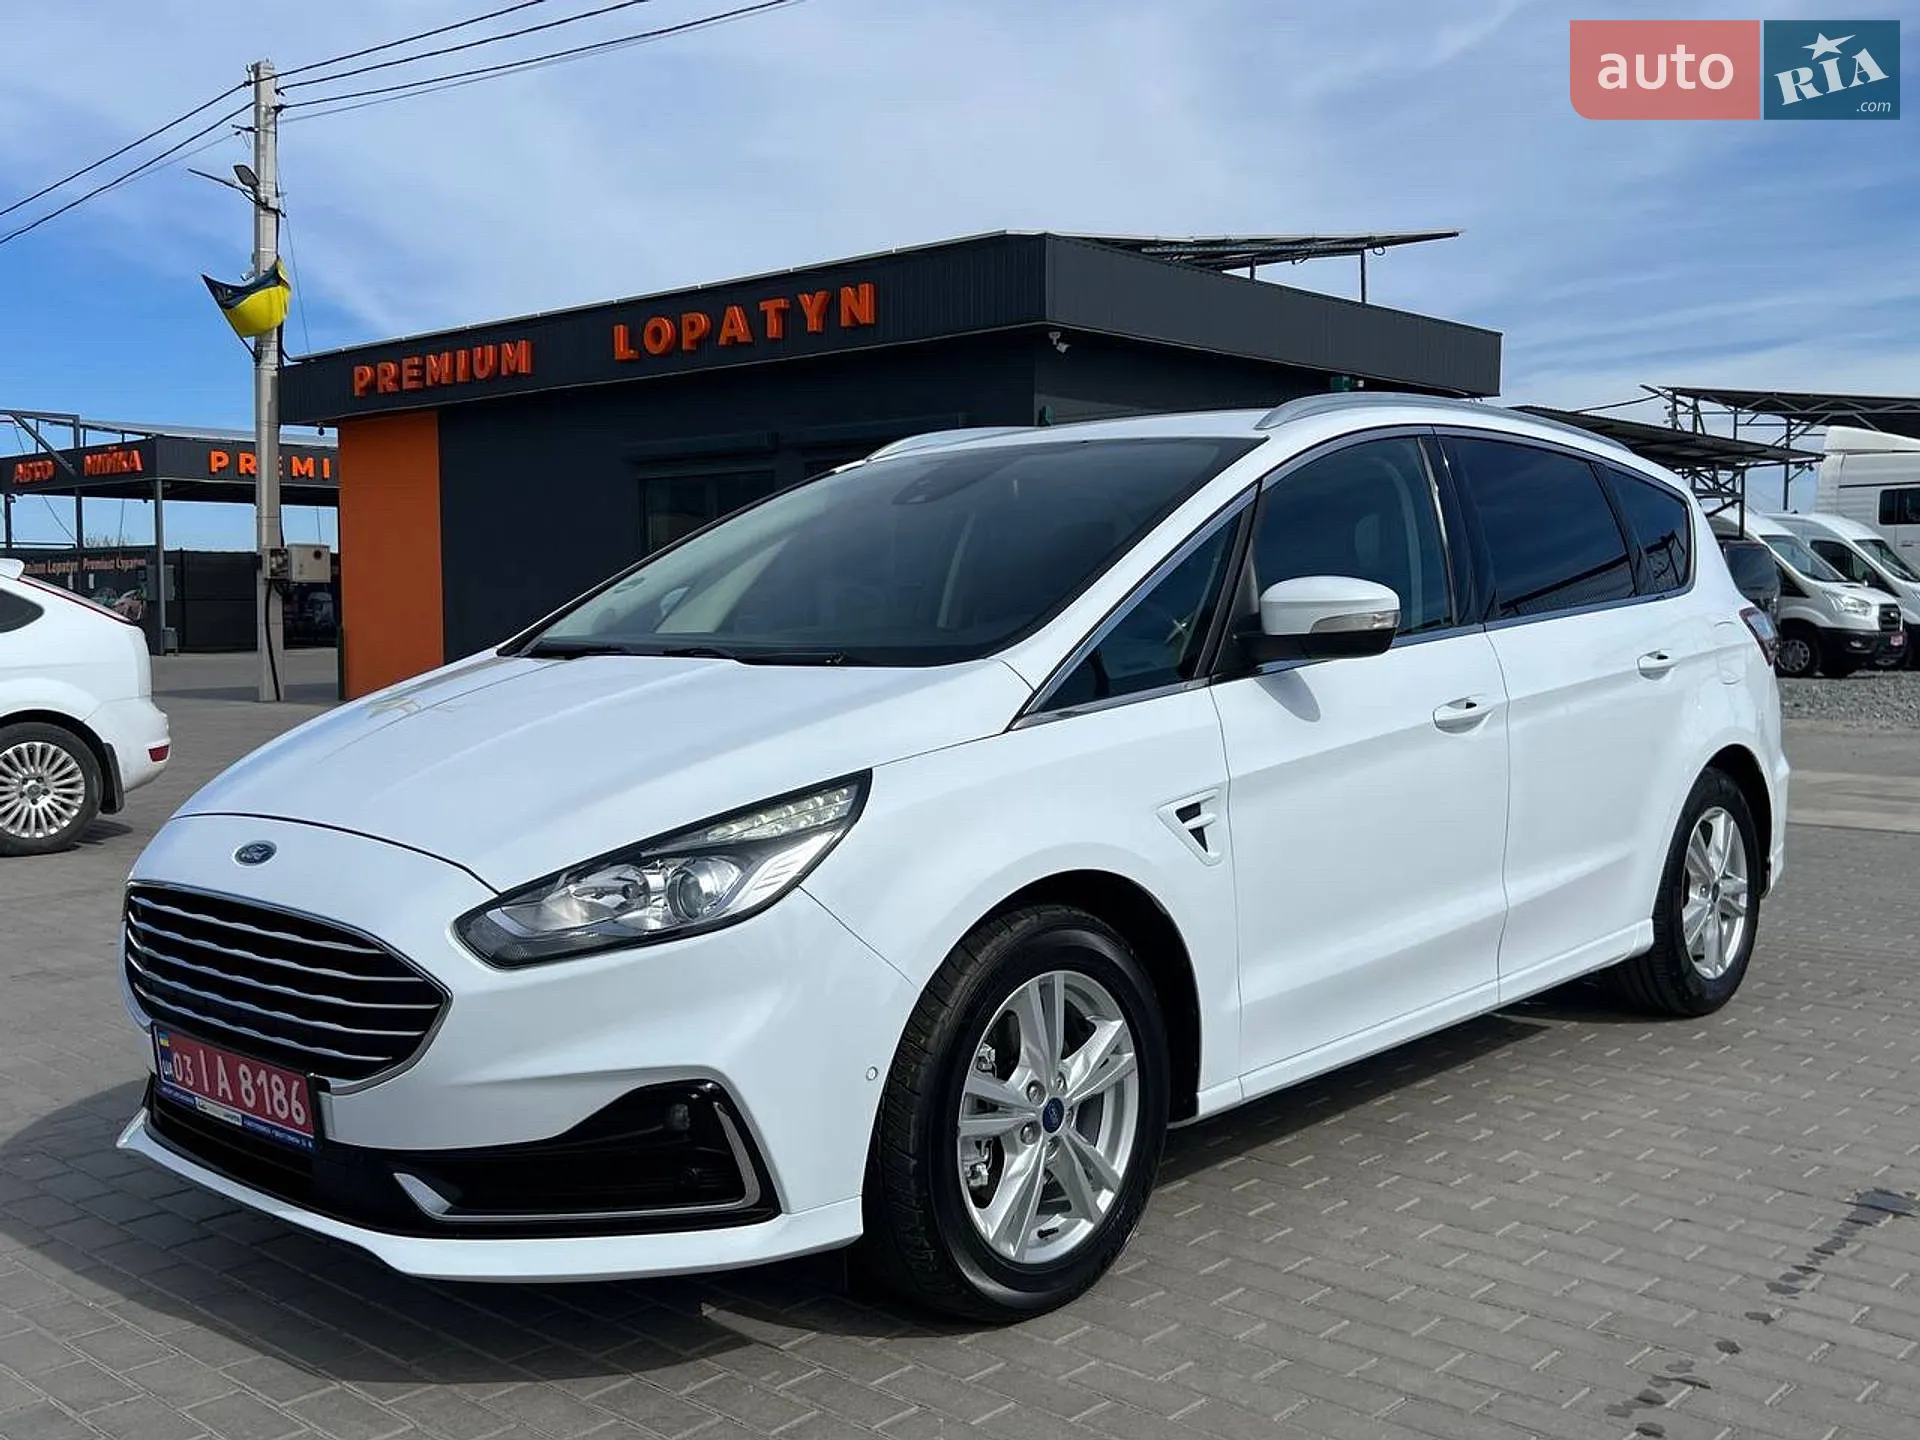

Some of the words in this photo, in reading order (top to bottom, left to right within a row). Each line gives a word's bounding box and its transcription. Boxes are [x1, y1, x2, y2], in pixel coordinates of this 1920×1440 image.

[352, 339, 534, 398] PREMIUM
[612, 282, 877, 362] LOPATYN
[209, 449, 331, 480] PRMI
[173, 1052, 195, 1087] 03
[238, 1063, 306, 1126] 8186
